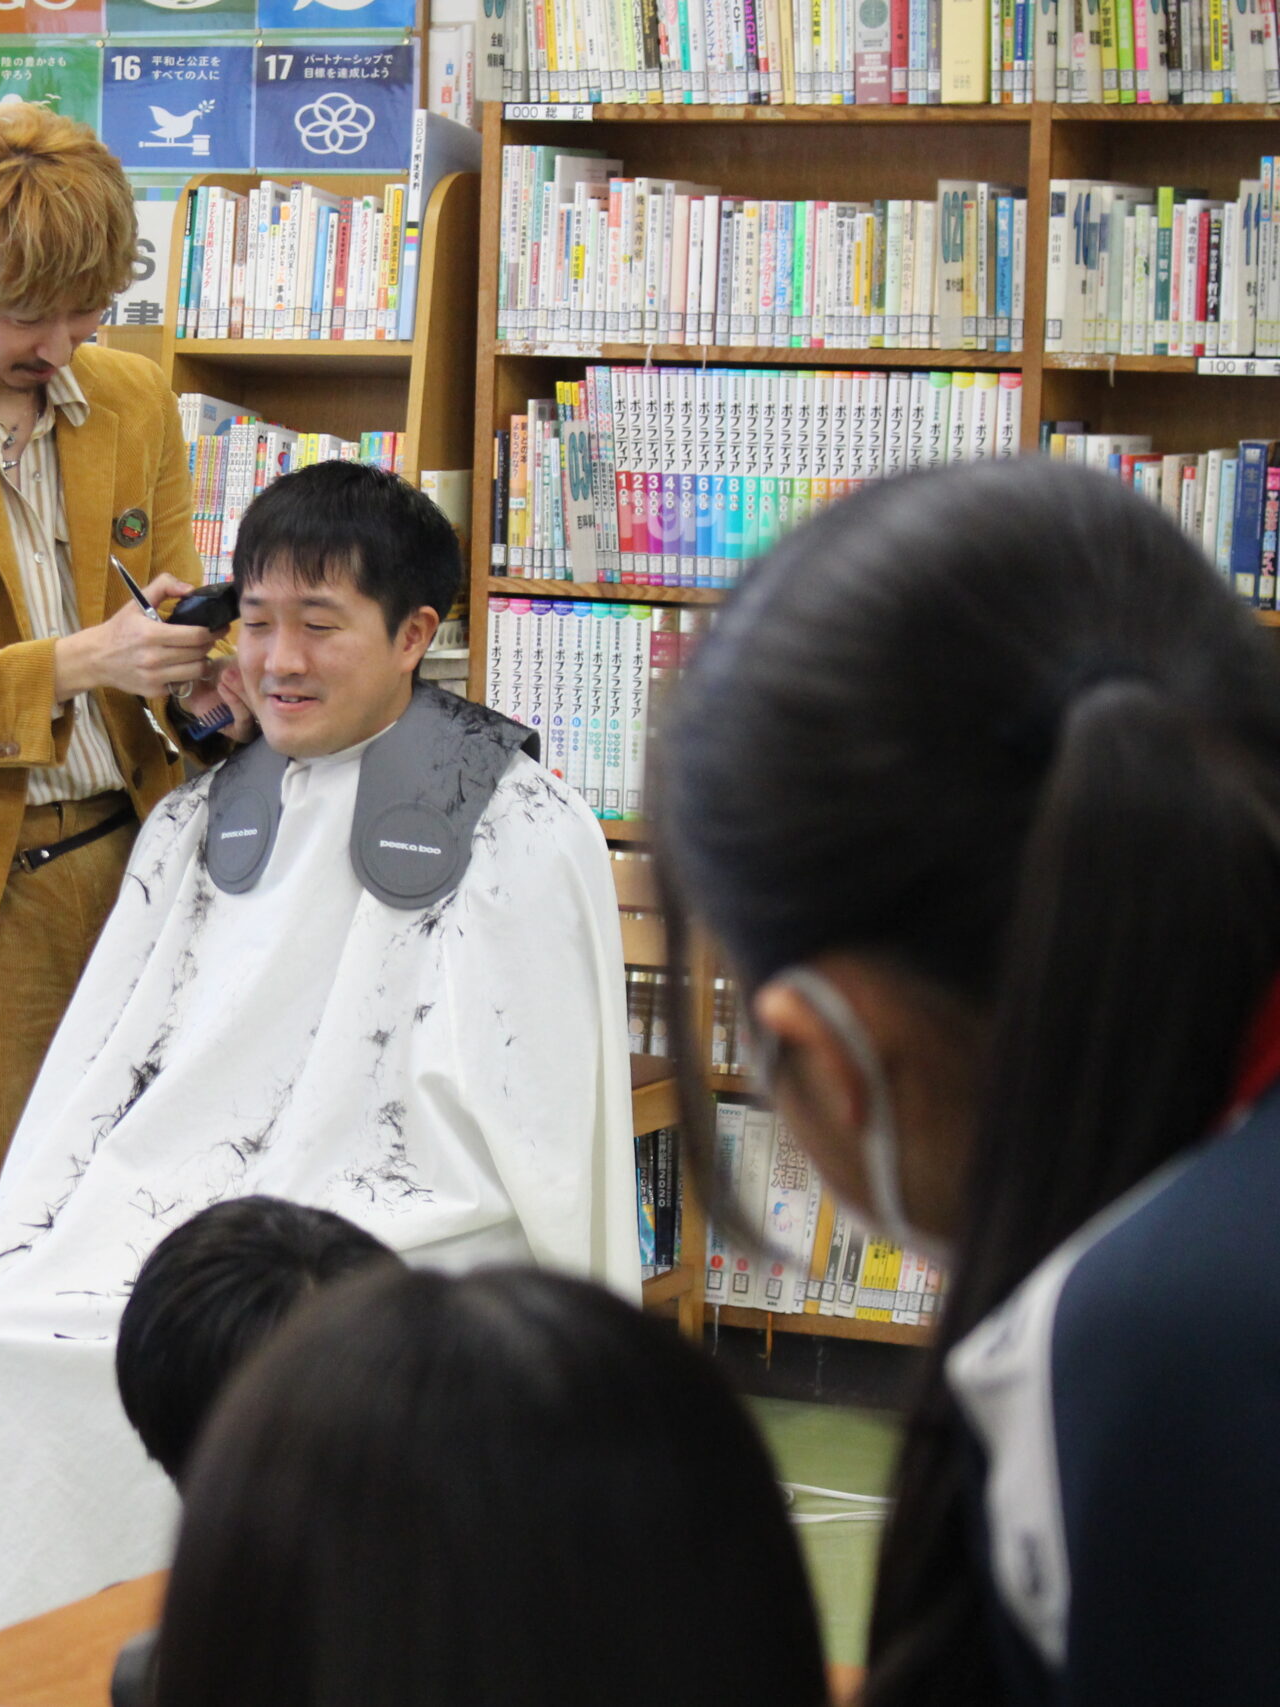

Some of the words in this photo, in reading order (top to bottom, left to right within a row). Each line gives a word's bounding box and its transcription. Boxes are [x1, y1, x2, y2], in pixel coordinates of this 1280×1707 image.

[0, 55, 68, 69] 陸の豊かさも
[0, 69, 34, 82] 守ろう
[111, 55, 142, 80] 16
[151, 55, 222, 69] 平和と公正を
[151, 69, 221, 82] すべての人に
[264, 54, 294, 81] 17
[303, 53, 394, 66] パートナーシップで
[303, 66, 391, 80] 目標を達成しよう
[511, 106, 538, 119] 000
[572, 107, 584, 119] 記
[130, 238, 157, 281] S
[1209, 361, 1236, 373] 100
[614, 399, 629, 469] ポプラディア
[630, 399, 644, 469] ポプラディア
[645, 399, 660, 469] ポプラディア
[663, 400, 676, 470] ポプラディア
[681, 401, 693, 472] ポプラディア
[697, 401, 710, 472] ポプラディア
[712, 401, 727, 472] ポプラディア
[728, 402, 743, 474] ポプラディア
[746, 403, 760, 474] ポプラディア
[762, 403, 777, 474] ポプラディア
[780, 403, 793, 475] ポプラディア
[797, 403, 811, 475] ポプラディア
[814, 403, 828, 475] ポプラディア
[832, 404, 847, 476] ポプラディア
[852, 405, 866, 476] ポプラディア
[868, 405, 882, 475] ポプラディア
[619, 474, 627, 487] 1
[632, 474, 643, 488] 2
[648, 474, 659, 488] 3
[664, 475, 675, 489] 4
[682, 475, 692, 490] 5
[698, 476, 709, 491] 6
[714, 477, 724, 491] 7
[729, 478, 740, 492] 8
[746, 478, 756, 493] 9
[511, 648, 524, 713] ポプラディア
[532, 648, 545, 713] ポプラディア
[554, 648, 566, 714] ポプラディア
[572, 650, 585, 716] ポプラディア
[591, 652, 604, 717] ポプラディア
[610, 652, 623, 718] ポプラディア
[630, 653, 644, 719] ポプラディア
[657, 1171, 666, 1208] 2020
[770, 1166, 809, 1192] 大百科
